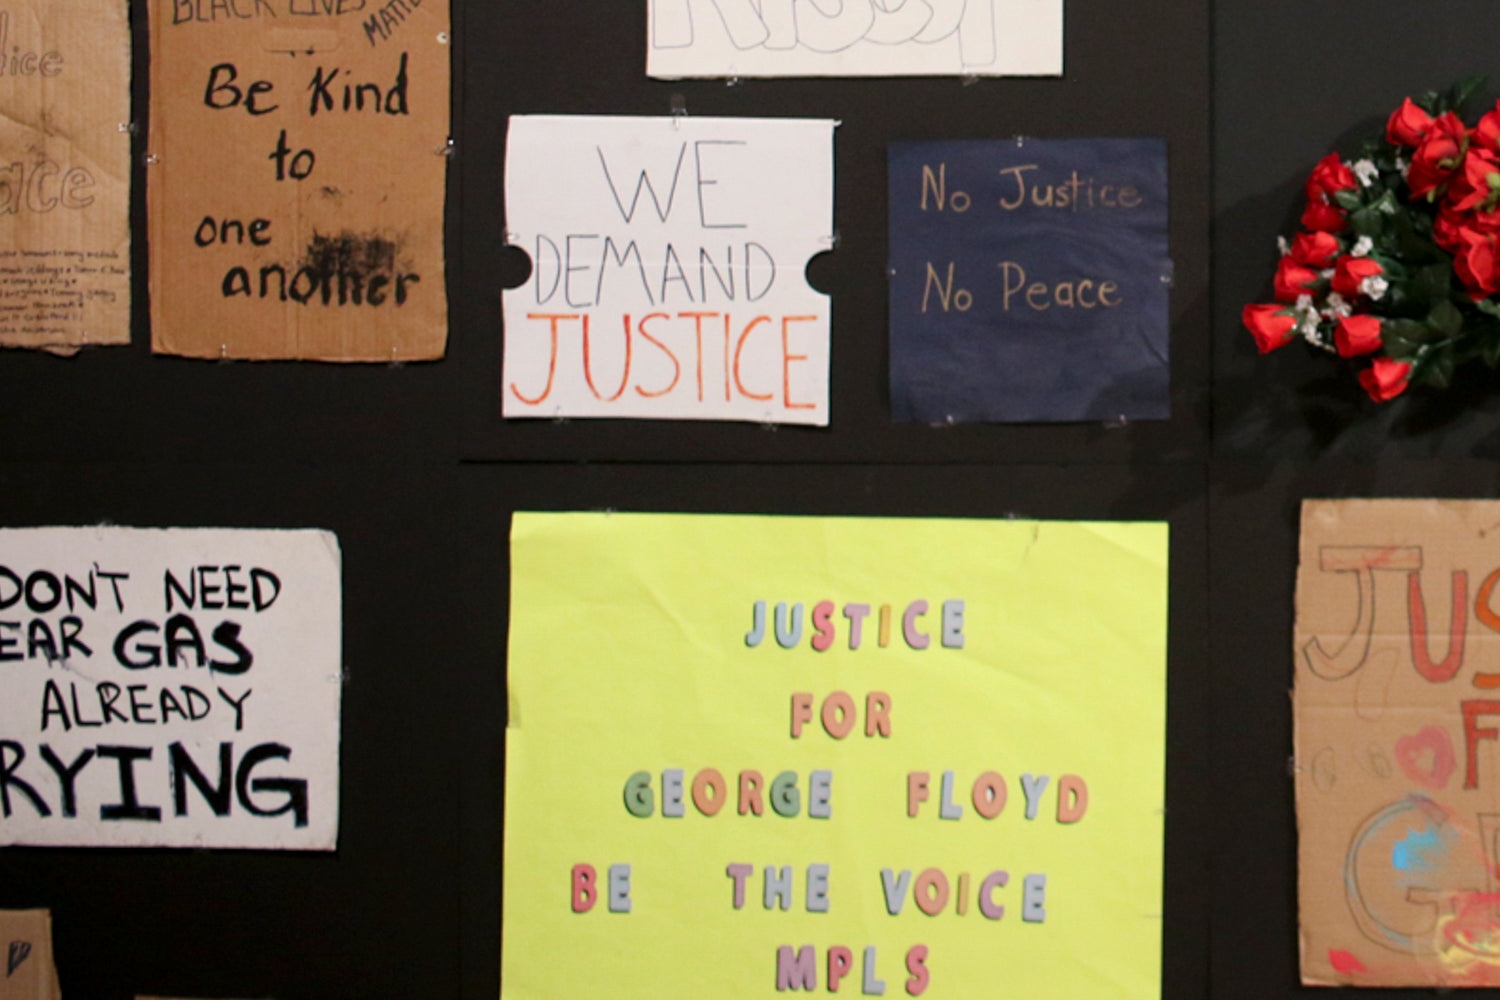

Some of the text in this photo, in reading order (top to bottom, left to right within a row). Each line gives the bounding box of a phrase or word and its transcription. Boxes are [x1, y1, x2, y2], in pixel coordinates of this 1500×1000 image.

[204, 52, 409, 115] Be Kind
[269, 129, 314, 181] to
[597, 140, 747, 228] WE
[920, 163, 1143, 212] No Justice
[194, 216, 271, 247] one
[222, 240, 420, 307] another
[535, 234, 775, 307] DEMAND
[921, 261, 1123, 313] No Peace
[509, 313, 817, 409] JUSTICE
[164, 565, 281, 612] NEED
[113, 613, 253, 675] GAS
[745, 600, 965, 652] JUSTICE
[41, 680, 252, 731] ALREADY
[790, 690, 892, 739] FOR
[623, 768, 1088, 824] GEORGE FLOYD
[571, 862, 1046, 922] BE THE VOICE
[776, 944, 930, 995] MPLS
